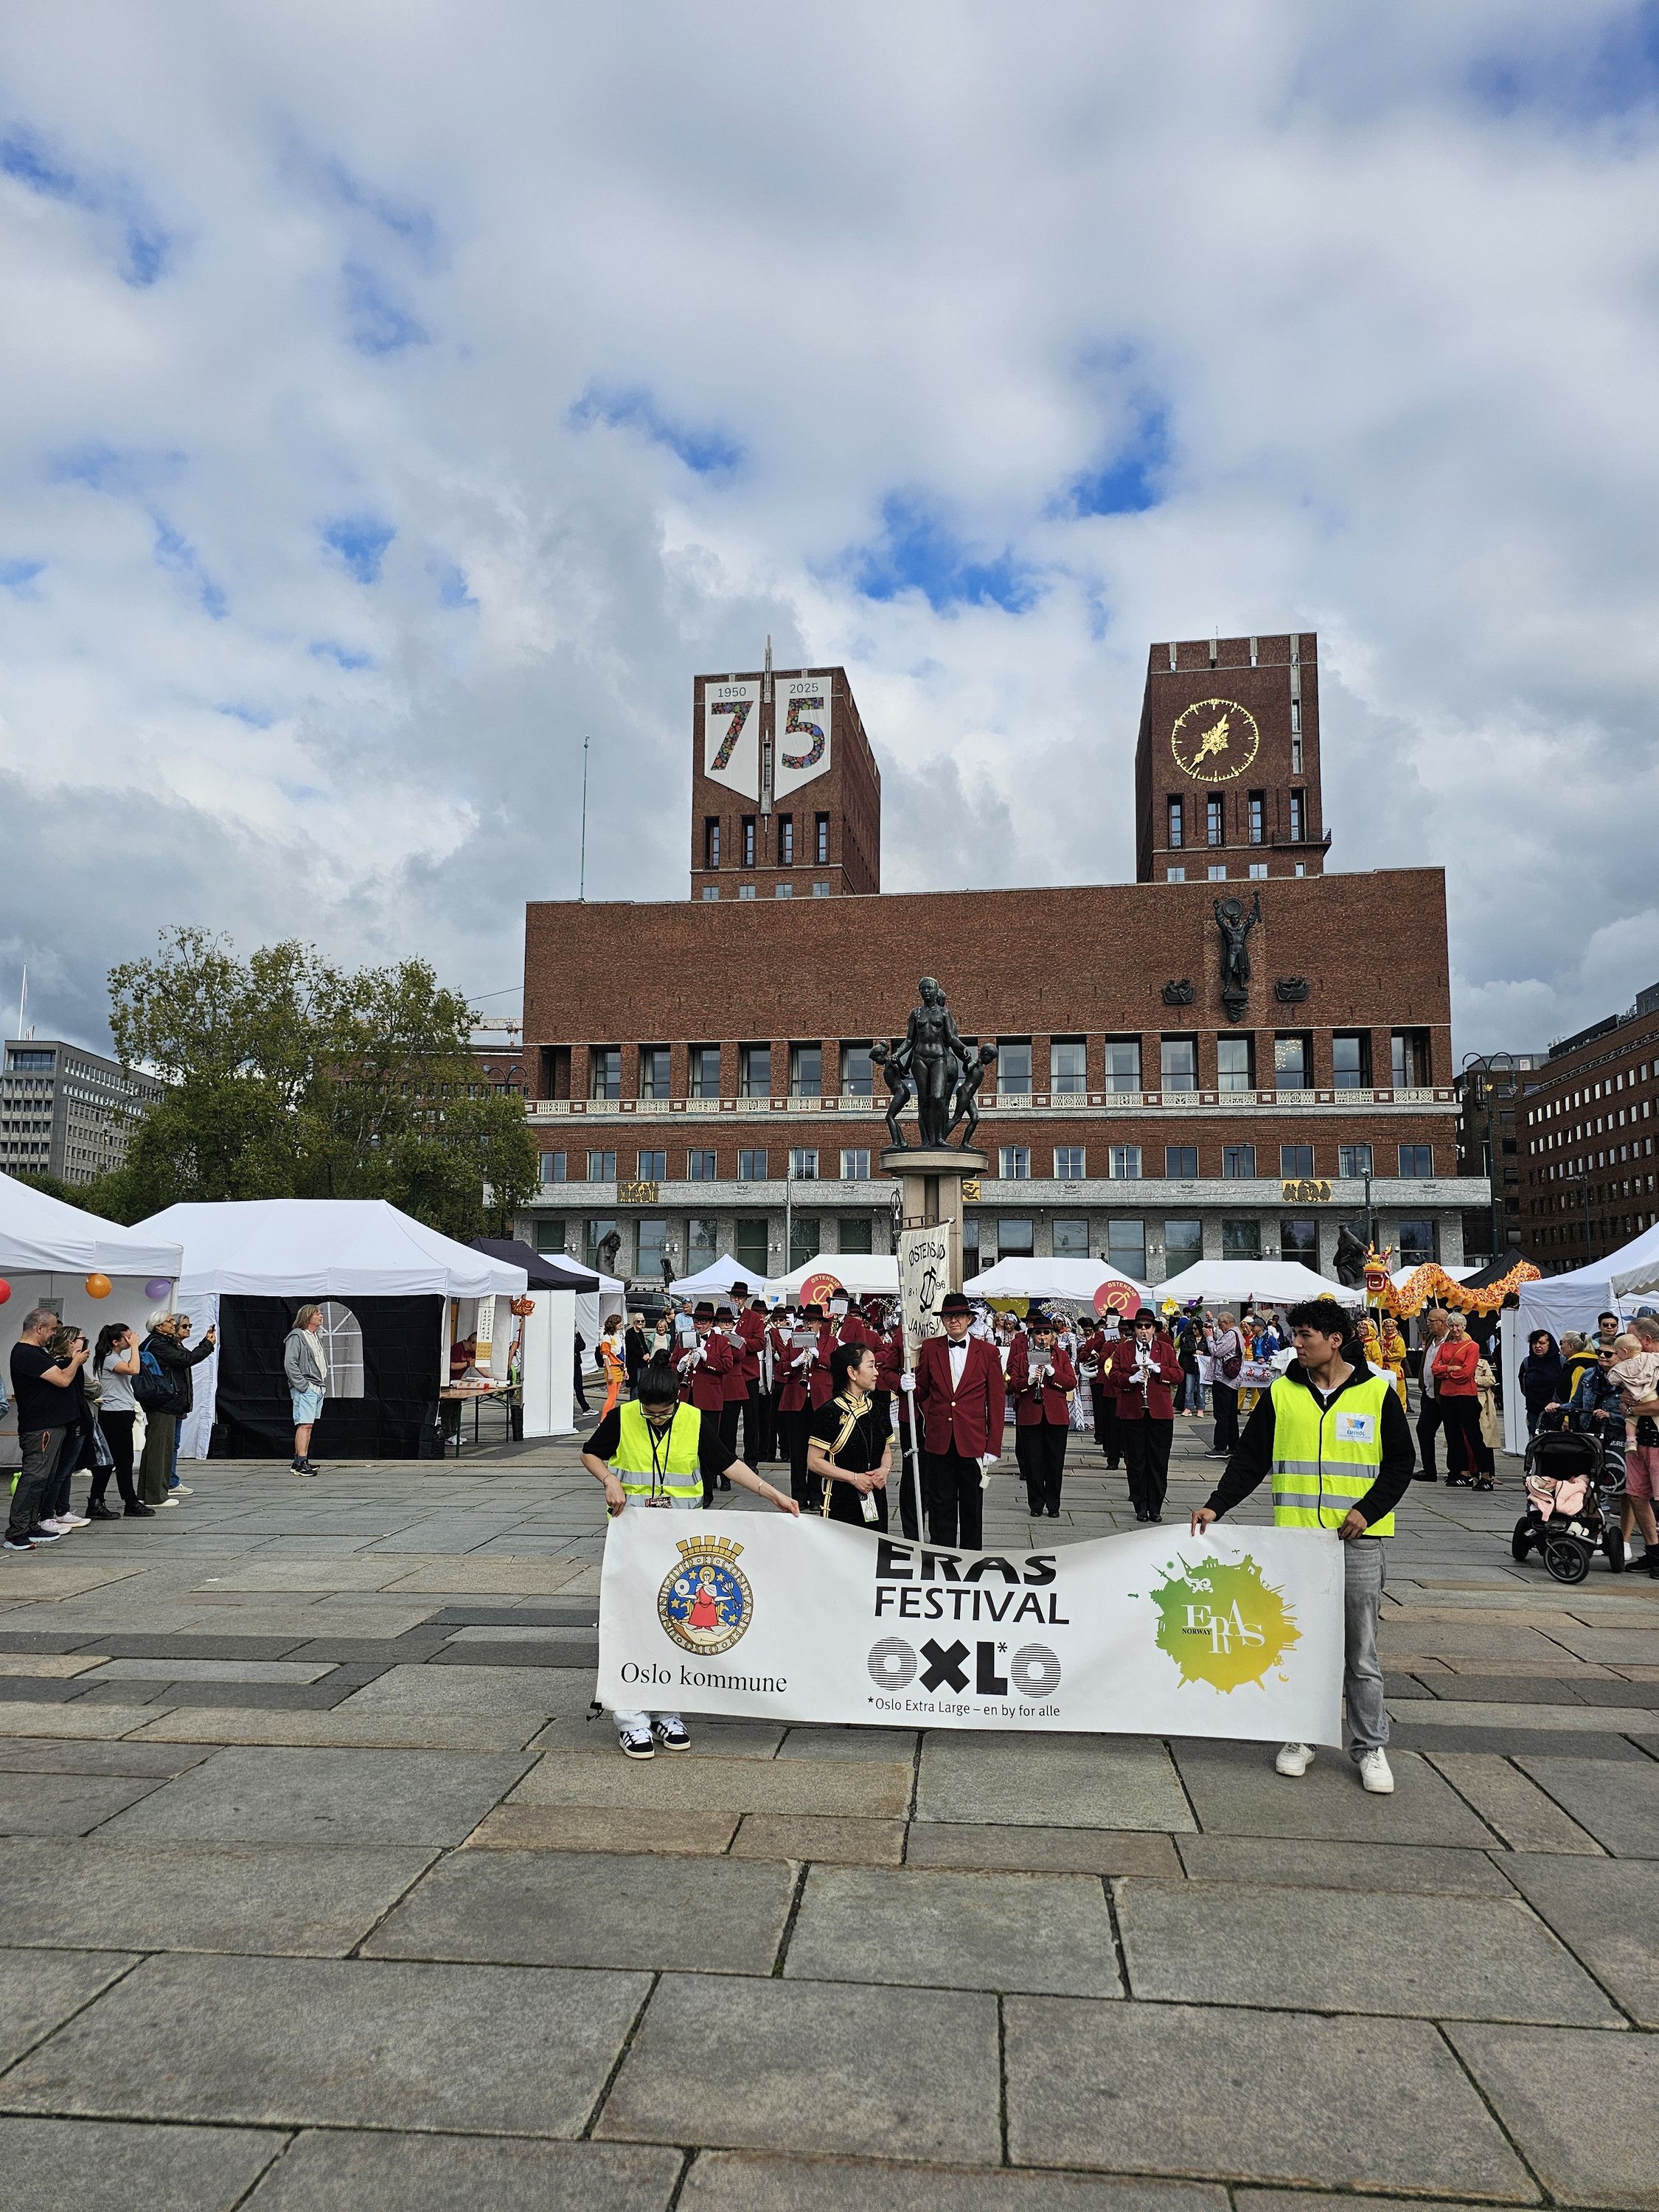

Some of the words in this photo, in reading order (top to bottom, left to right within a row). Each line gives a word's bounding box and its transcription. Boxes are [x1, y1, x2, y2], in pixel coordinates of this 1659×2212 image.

[717, 686, 746, 698] 1950
[790, 683, 818, 694] 2025
[908, 1242, 945, 1267] ØSTENSJØ
[908, 1318, 942, 1338] JANITSJ
[875, 1537, 1057, 1586] ERAS
[874, 1586, 1070, 1624] FESTIVAL
[1180, 1599, 1265, 1654] ERAS
[621, 1662, 672, 1684] Oslo
[679, 1665, 787, 1693] kommune
[905, 1699, 935, 1712] Extra
[939, 1701, 970, 1717] Large
[984, 1705, 998, 1715] en
[1001, 1704, 1015, 1719] by
[1019, 1704, 1035, 1717] for
[1038, 1705, 1060, 1717] alle
